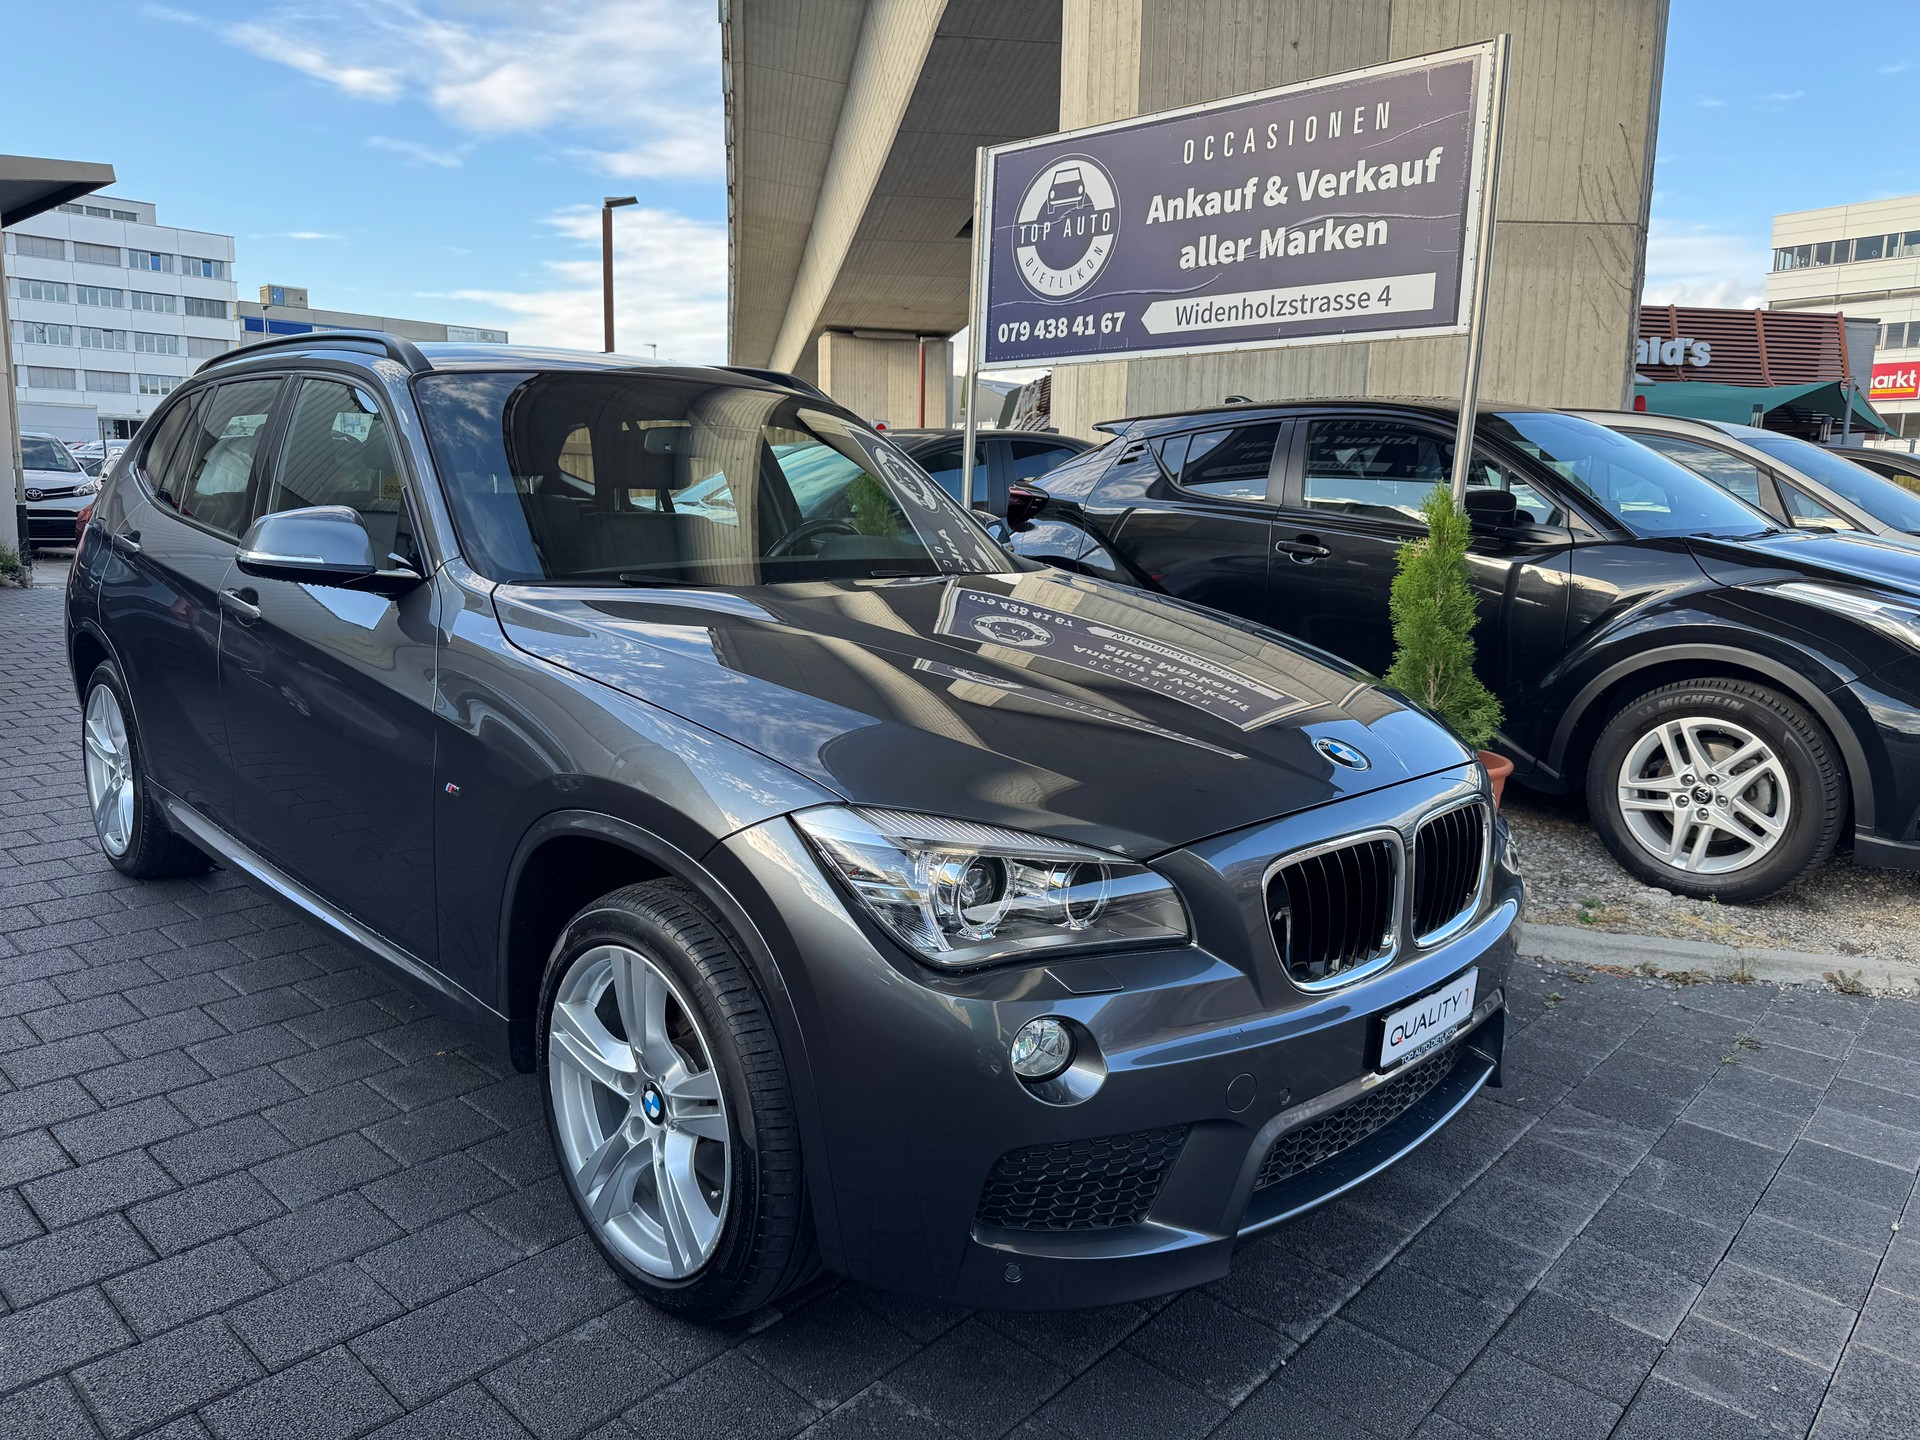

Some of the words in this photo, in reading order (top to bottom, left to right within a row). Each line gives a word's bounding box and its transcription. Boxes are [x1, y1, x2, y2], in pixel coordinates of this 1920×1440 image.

[1183, 101, 1391, 165] OCCASIONEN
[1145, 177, 1259, 224] Ankauf
[1263, 175, 1289, 207] &
[1296, 147, 1444, 202] Verkauf
[1020, 222, 1051, 244] TOP
[1063, 212, 1111, 238] AUTO
[1179, 234, 1253, 270] aller
[1259, 218, 1388, 260] Marken
[1025, 246, 1104, 289] DIETLIKON
[1175, 288, 1371, 327] Widenholzstrasse
[1377, 285, 1392, 307] 4
[997, 320, 1030, 344] 079
[1034, 317, 1069, 340] 438
[1072, 313, 1096, 337] 41
[1100, 311, 1126, 334] 67
[1635, 336, 1712, 367] ald's
[1658, 694, 1744, 711] MICHELIN
[1390, 991, 1463, 1047] QUALITY
